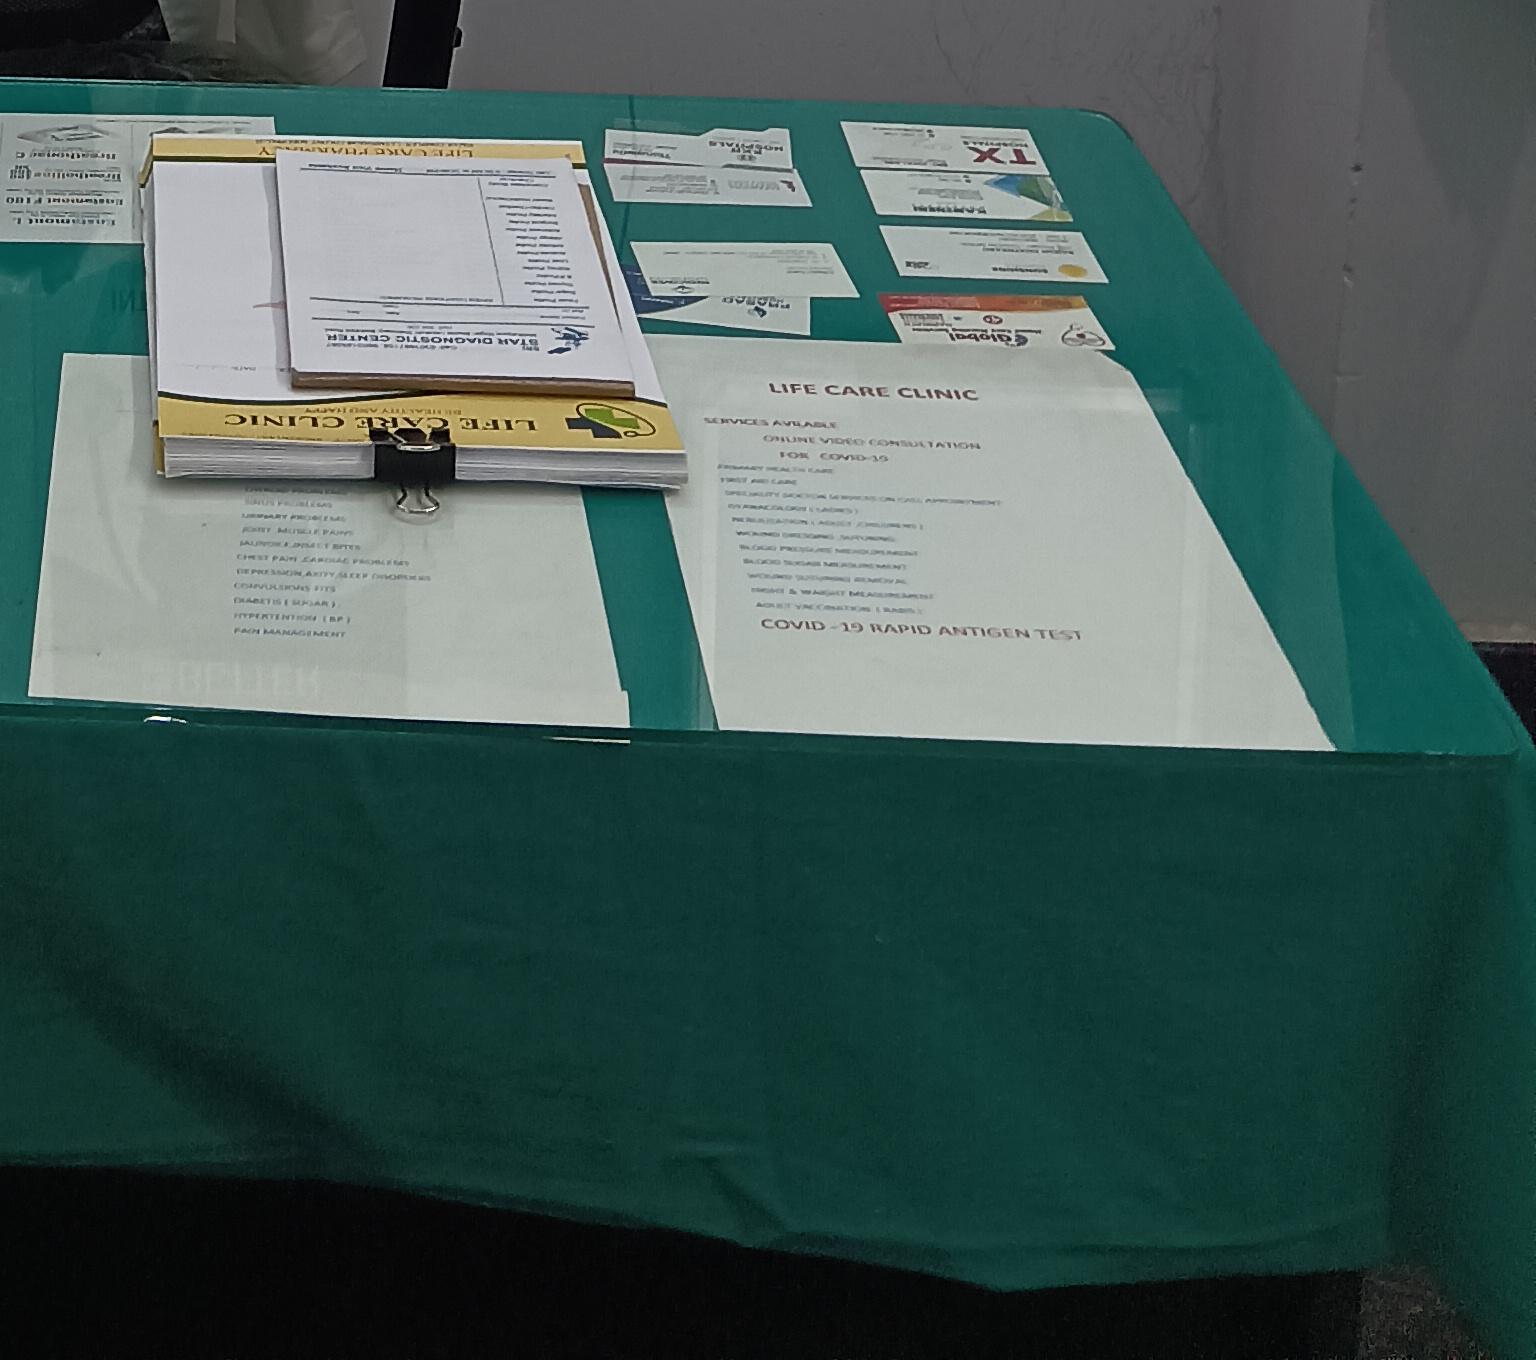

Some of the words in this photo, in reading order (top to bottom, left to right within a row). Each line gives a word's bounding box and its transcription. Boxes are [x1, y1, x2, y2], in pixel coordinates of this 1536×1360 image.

[967, 147, 1037, 166] TX
[326, 333, 390, 343] CENTER
[396, 335, 493, 345] DIAGNOSTIC
[498, 338, 538, 346] STAR
[768, 382, 817, 395] LIFE
[824, 384, 890, 399] CARE
[897, 386, 980, 401] CLINIC
[223, 413, 345, 429] CLINIC
[459, 417, 535, 432] LIFE
[704, 416, 769, 426] SERVICES
[763, 434, 816, 444] ONLINE
[819, 436, 864, 446] VIDEO
[868, 438, 981, 450] CONSULTATION
[779, 451, 809, 460] FOR
[761, 618, 826, 631] COVID
[870, 623, 932, 636] RAPID
[938, 624, 1031, 640] ANTIGEN
[1037, 628, 1084, 641] TEST
